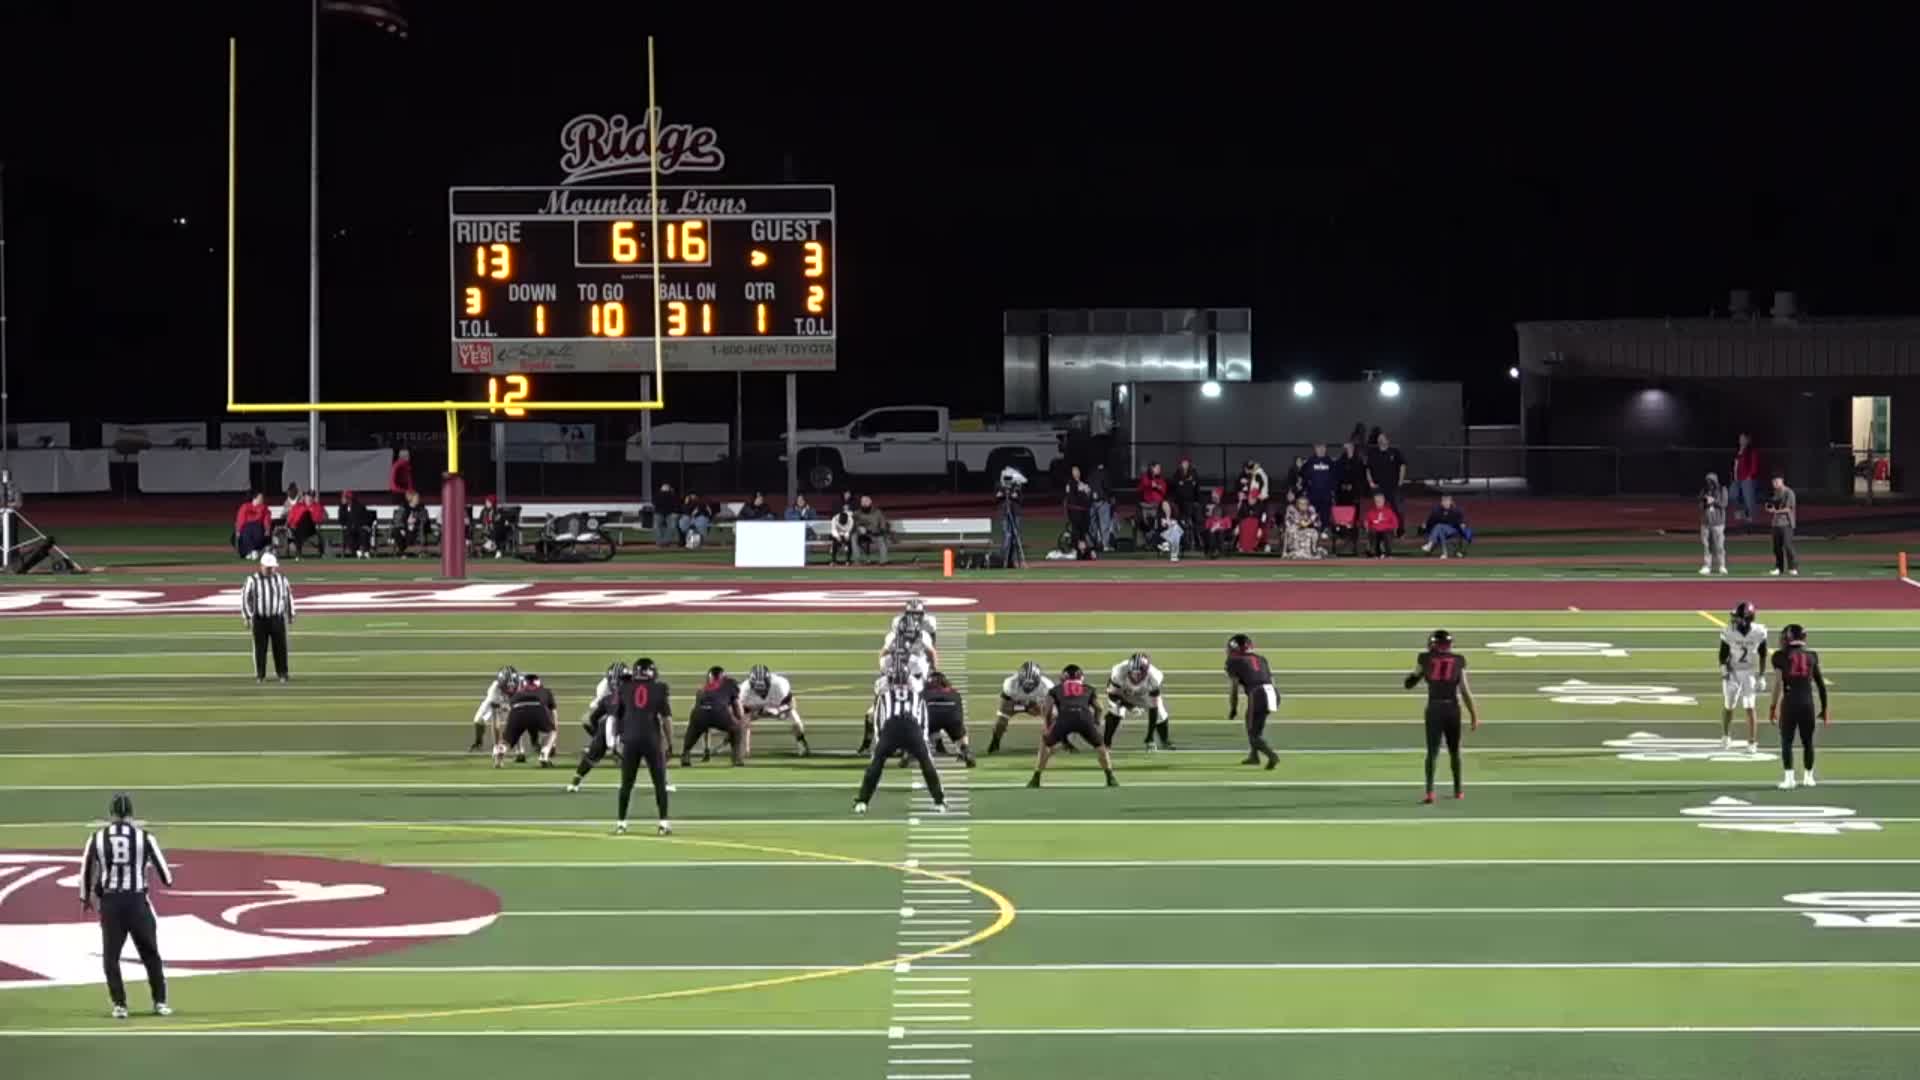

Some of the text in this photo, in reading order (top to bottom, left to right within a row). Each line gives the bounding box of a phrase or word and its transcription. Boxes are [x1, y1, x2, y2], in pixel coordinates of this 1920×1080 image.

[560, 107, 725, 178] Ridge
[538, 189, 747, 214] Mountain Lions
[457, 222, 521, 242] RIDGE
[751, 220, 820, 241] GUEST
[476, 244, 511, 279] 13
[804, 242, 824, 278] 3
[465, 286, 482, 315] 3
[508, 285, 556, 302] DOWN
[578, 284, 624, 301] TO GO
[659, 283, 717, 300] BALL ON
[744, 282, 776, 301] QTR
[806, 285, 825, 313] 2
[459, 320, 498, 338] T.O.L.
[534, 304, 546, 335] 1
[590, 301, 626, 337] 10
[666, 302, 712, 336] 31
[755, 304, 767, 333] 1
[794, 318, 833, 336] T.O.L.
[459, 351, 492, 365] YES!
[488, 375, 529, 416] 12
[1737, 646, 1748, 663] 2
[633, 682, 649, 709] 0
[109, 836, 130, 863] B
